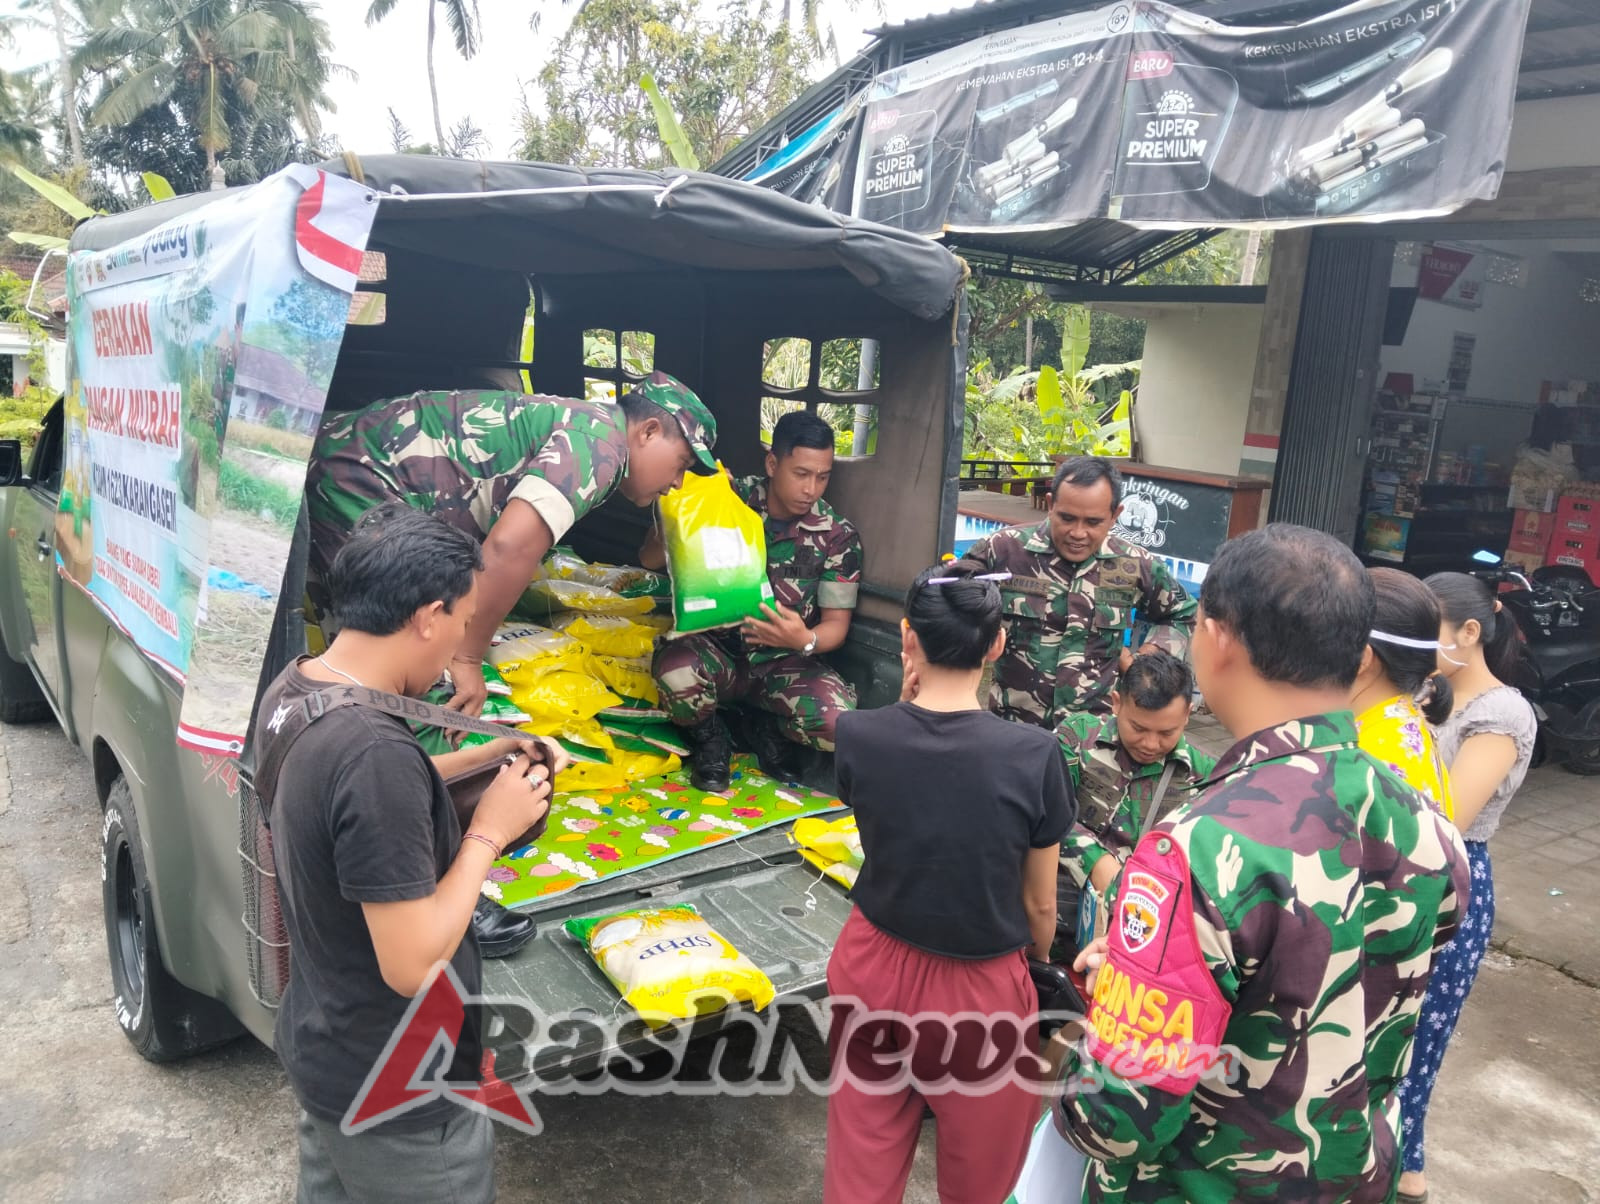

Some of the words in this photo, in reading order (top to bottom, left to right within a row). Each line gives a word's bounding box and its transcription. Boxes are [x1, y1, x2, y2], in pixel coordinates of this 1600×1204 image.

[1245, 33, 1342, 59] KEMEWAHAN
[1345, 14, 1416, 43] EKSTRA
[1420, 4, 1440, 21] ISI
[1016, 62, 1056, 79] EKSTRA
[1133, 58, 1170, 73] BARU
[1144, 118, 1200, 138] SUPER
[1127, 138, 1207, 159] PREMIUM
[865, 168, 923, 193] PREMIUM
[875, 154, 916, 176] SUPER
[92, 300, 153, 357] GERAKAN
[126, 388, 180, 449] MURAH
[122, 473, 177, 534] KARANGASEM
[1121, 476, 1189, 510] gkringan
[368, 688, 431, 719] POLO
[639, 935, 712, 961] SPHP
[1093, 963, 1194, 1044] BINSA
[1089, 1006, 1190, 1073] SIBETAN
